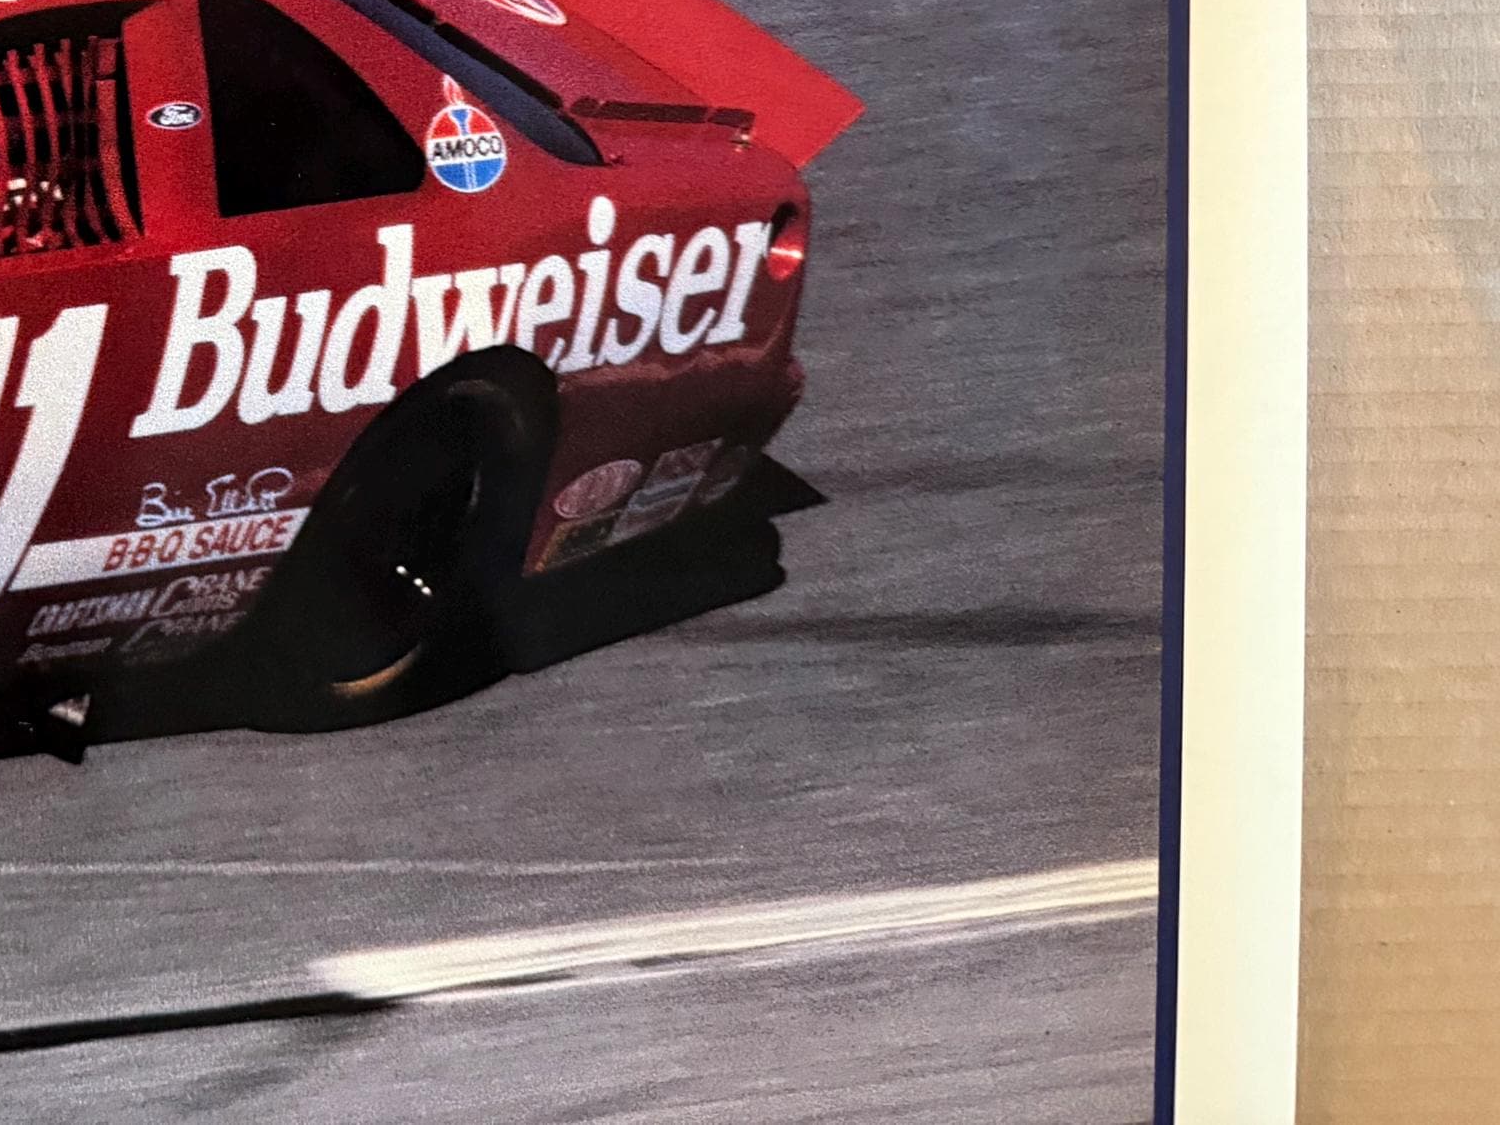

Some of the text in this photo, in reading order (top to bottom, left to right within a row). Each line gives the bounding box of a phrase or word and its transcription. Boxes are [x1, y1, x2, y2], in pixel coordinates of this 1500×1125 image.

[430, 134, 502, 163] AMOCO
[128, 195, 772, 440] Budweiser
[189, 514, 294, 561] SAUCE
